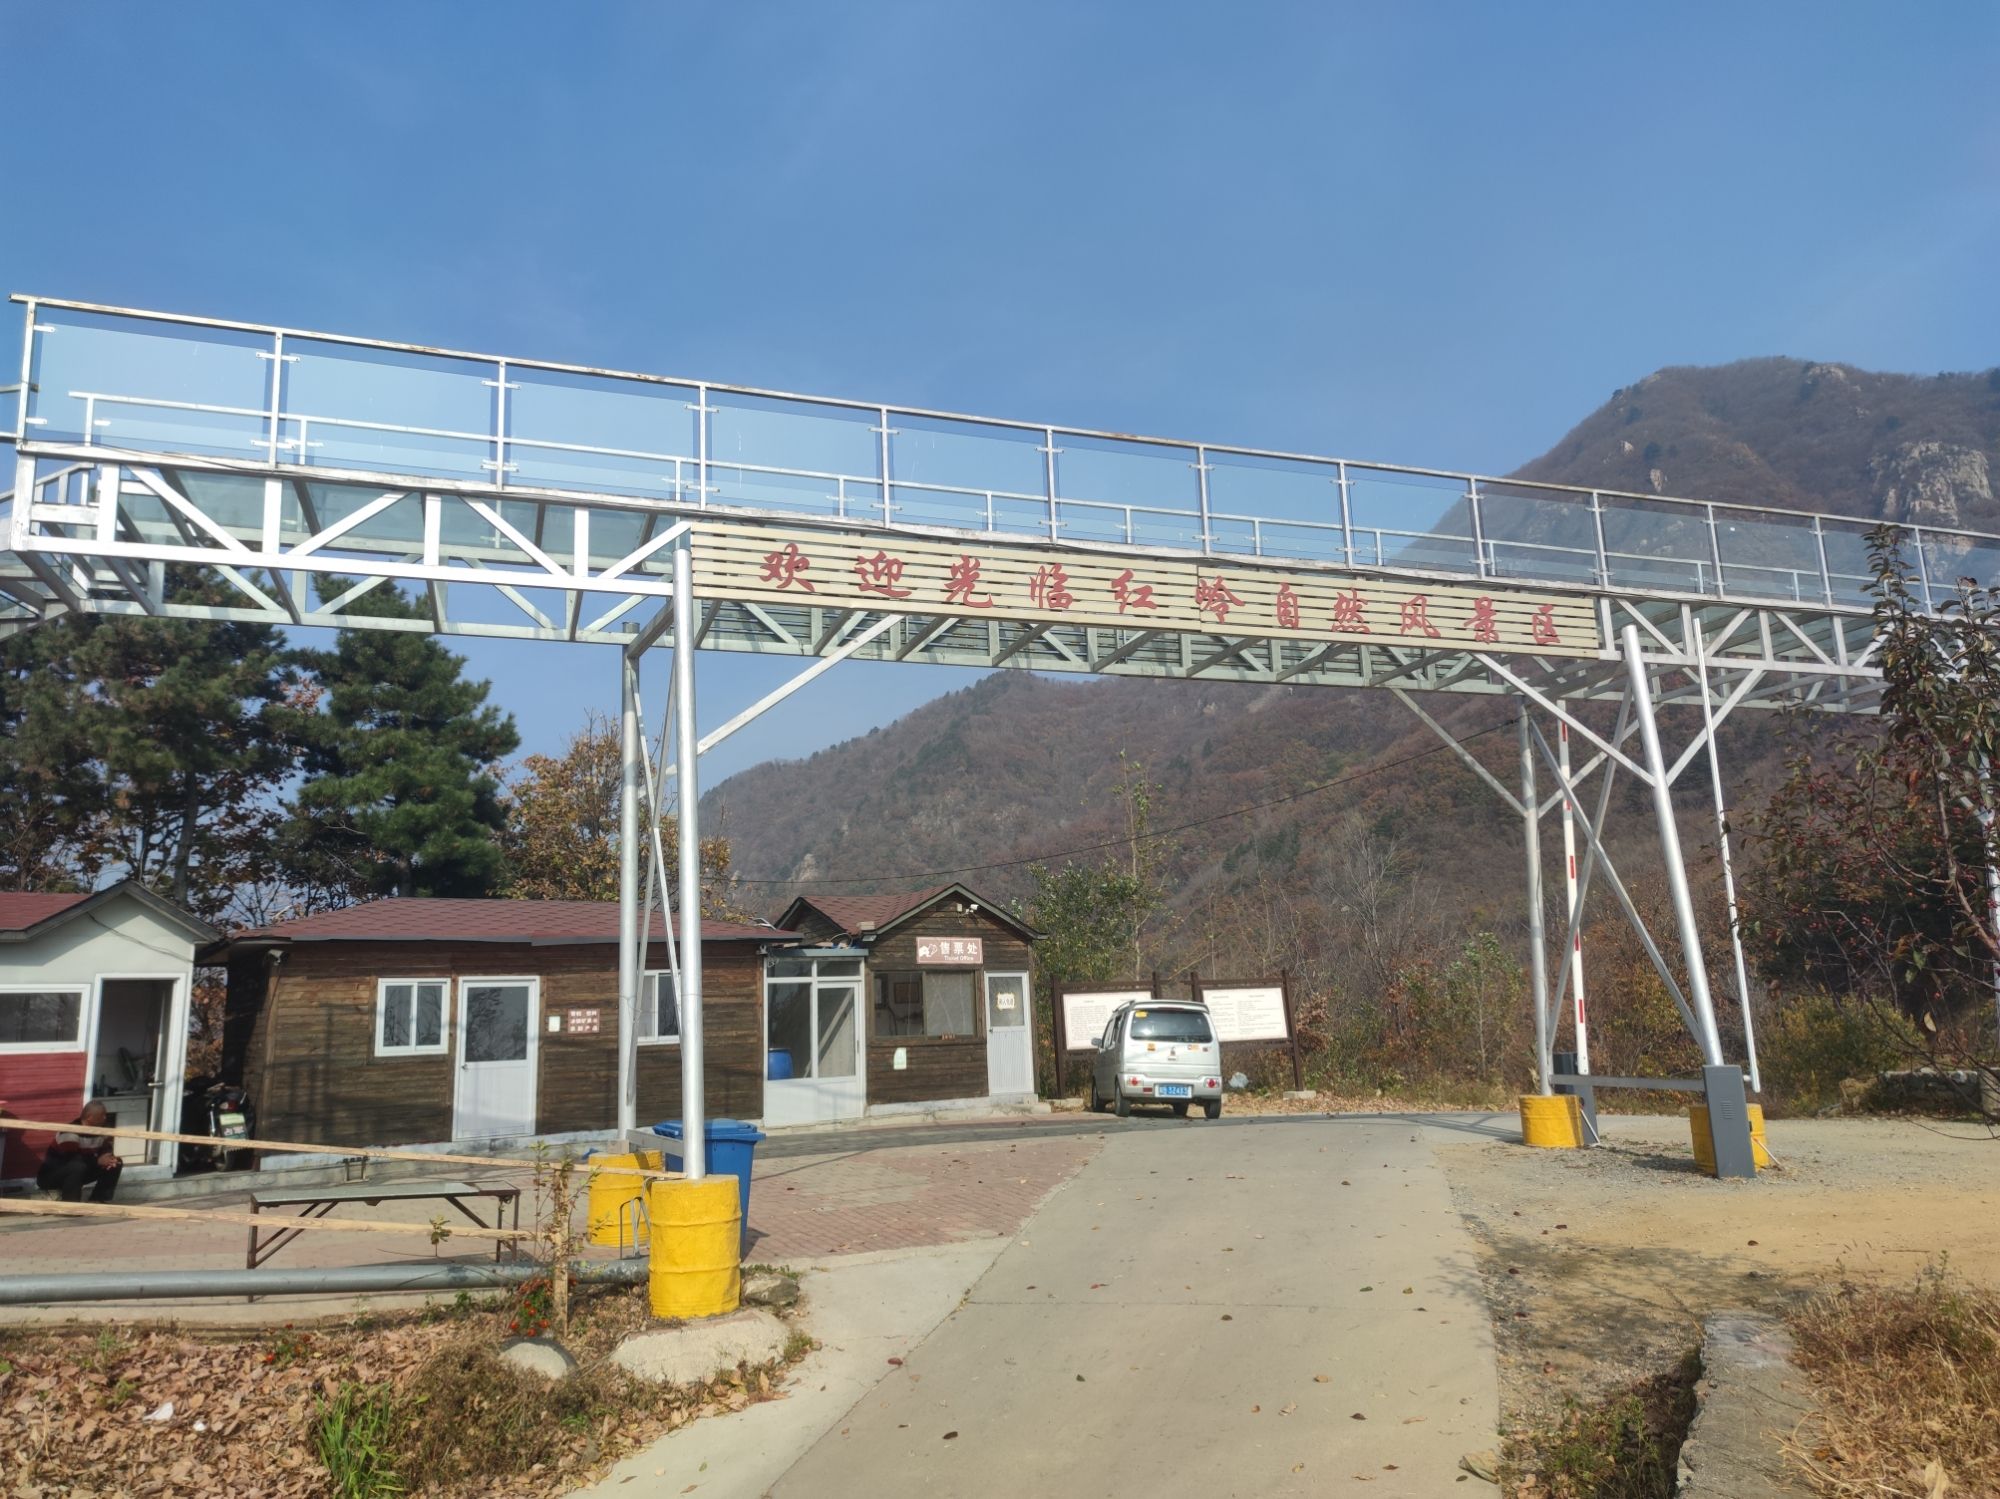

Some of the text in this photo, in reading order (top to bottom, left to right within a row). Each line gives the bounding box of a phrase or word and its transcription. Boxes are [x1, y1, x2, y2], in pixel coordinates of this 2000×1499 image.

[760, 542, 1561, 646] 欢迎光临红岭自然风景区
[939, 941, 978, 955] 售票处
